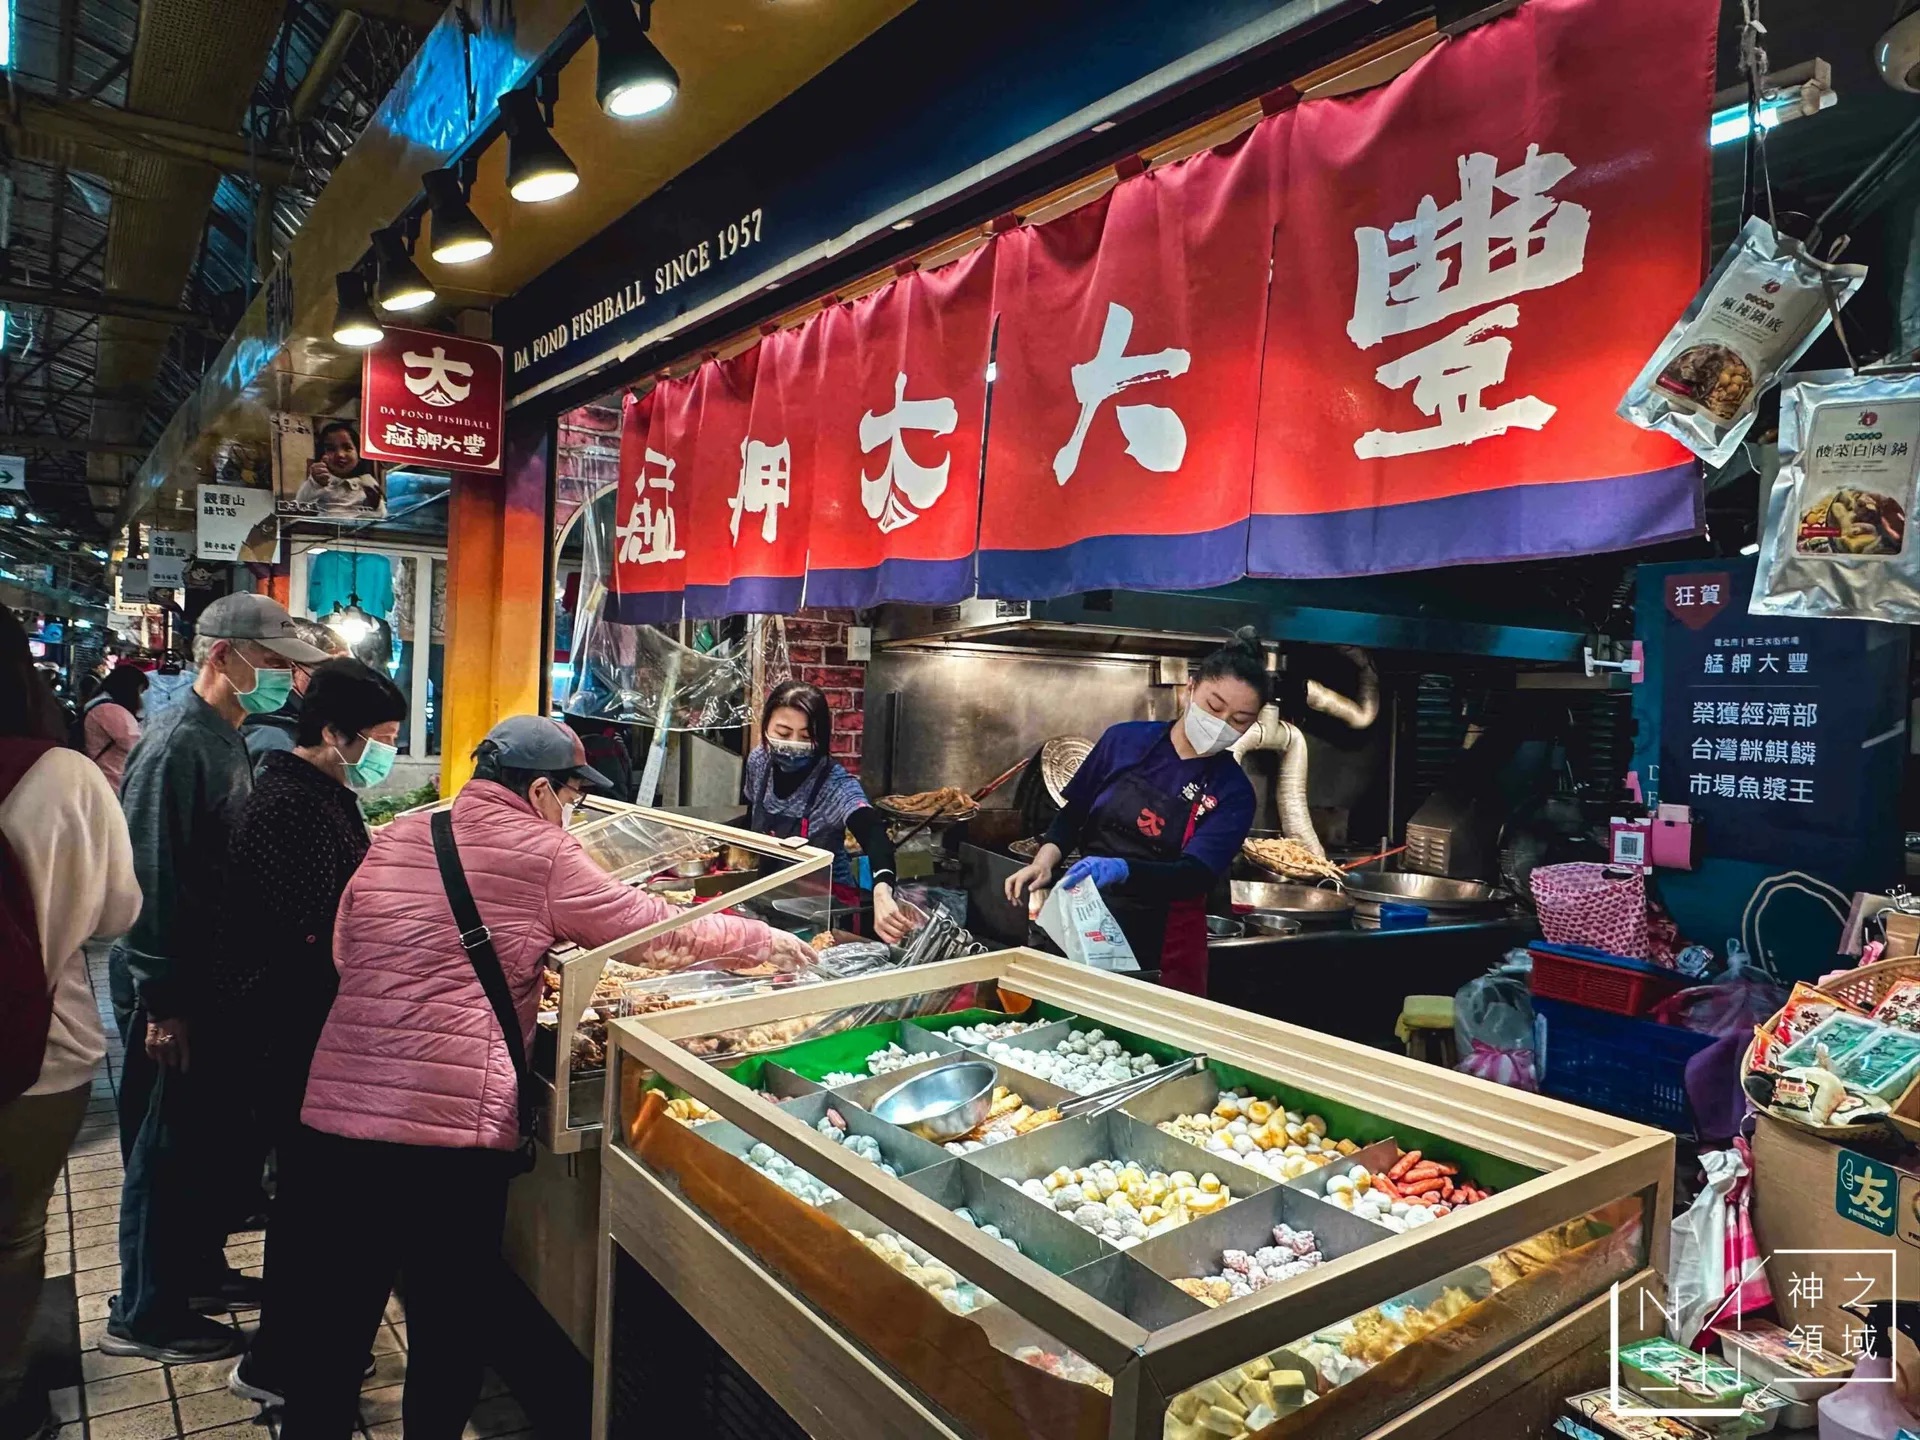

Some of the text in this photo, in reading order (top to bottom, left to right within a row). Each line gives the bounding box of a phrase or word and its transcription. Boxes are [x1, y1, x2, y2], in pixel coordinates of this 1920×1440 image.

[514, 208, 763, 373] DA FOND FISHBALL SINCE 1957
[380, 405, 492, 430] DA FOND FISHBALL
[381, 421, 486, 457] 艋舺大豐
[1674, 584, 1721, 607] 狂賀
[1703, 652, 1809, 674] 艋舺大豐
[1691, 701, 1818, 728] 榮獲經濟部
[1689, 772, 1815, 804] 市場魚漿王
[1848, 1166, 1892, 1218] 友
[1848, 1207, 1885, 1228] FRIENDLY
